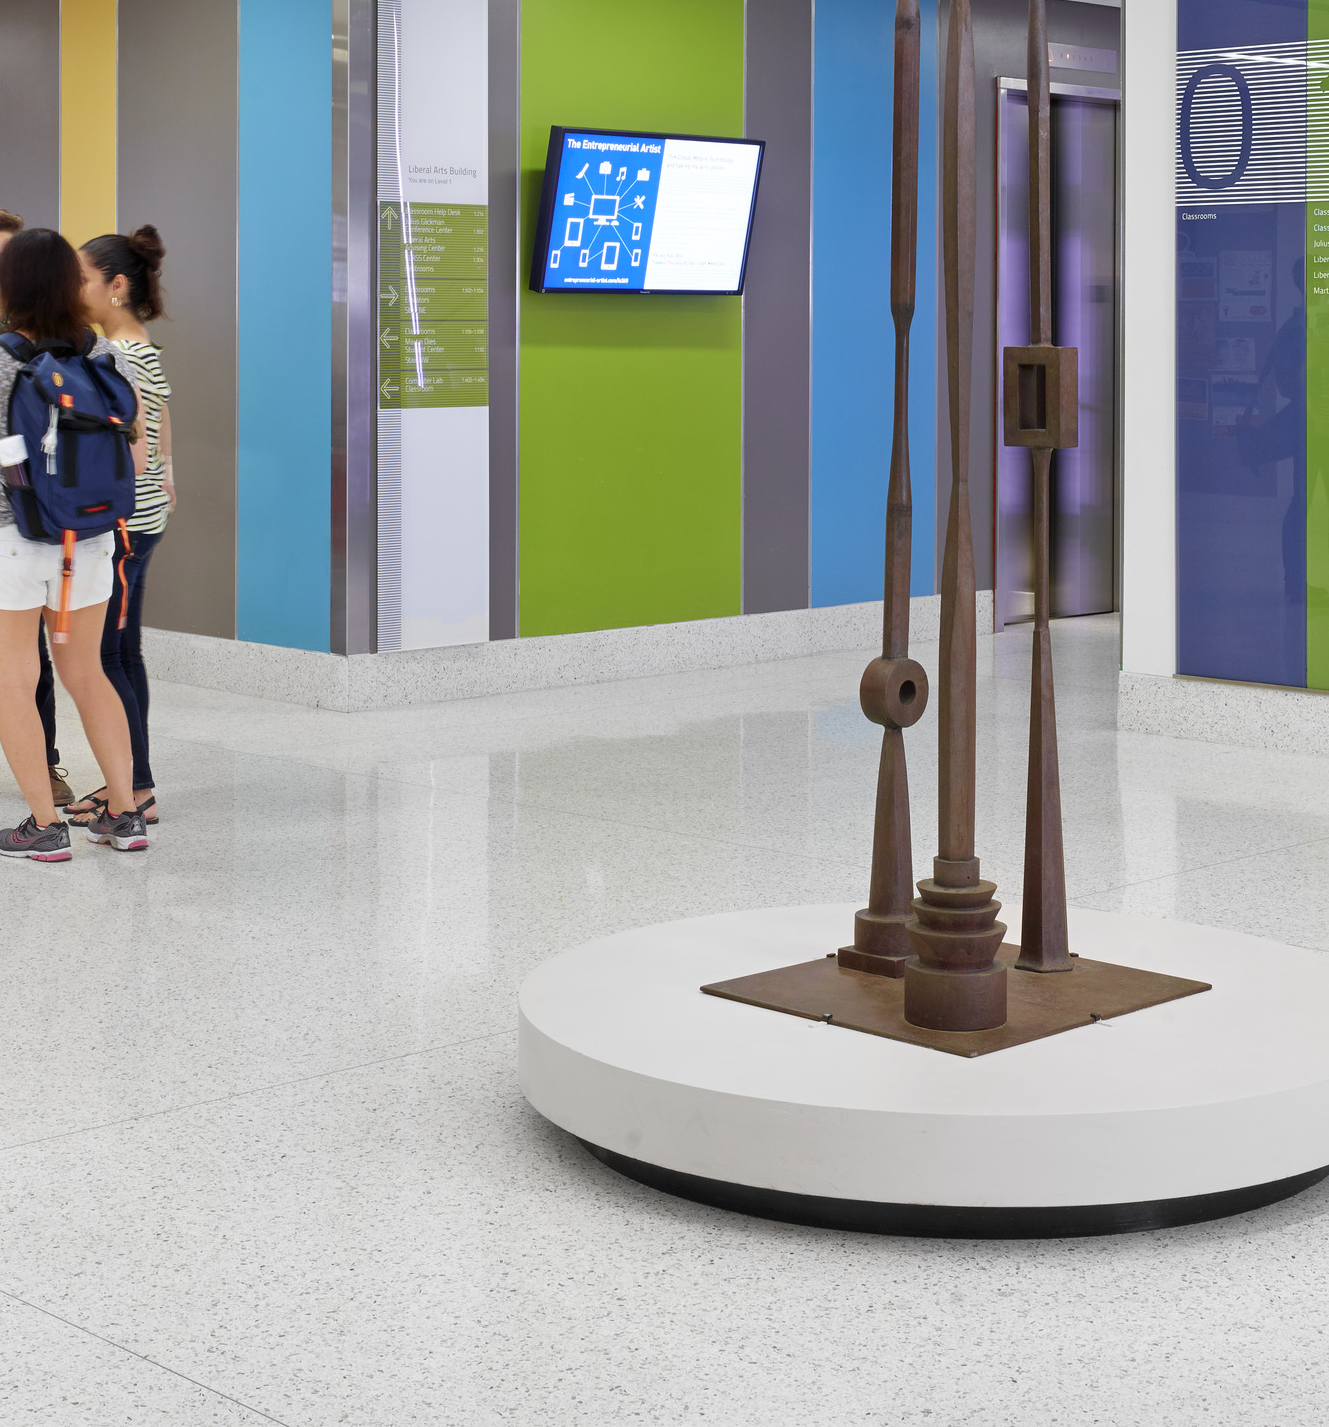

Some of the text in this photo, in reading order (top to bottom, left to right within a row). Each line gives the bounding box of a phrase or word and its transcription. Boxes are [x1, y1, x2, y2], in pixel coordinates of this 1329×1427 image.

[1180, 63, 1253, 189] 0
[567, 139, 661, 154] The Entrepreneurial Artist
[408, 165, 477, 178] Liberal Arts Building
